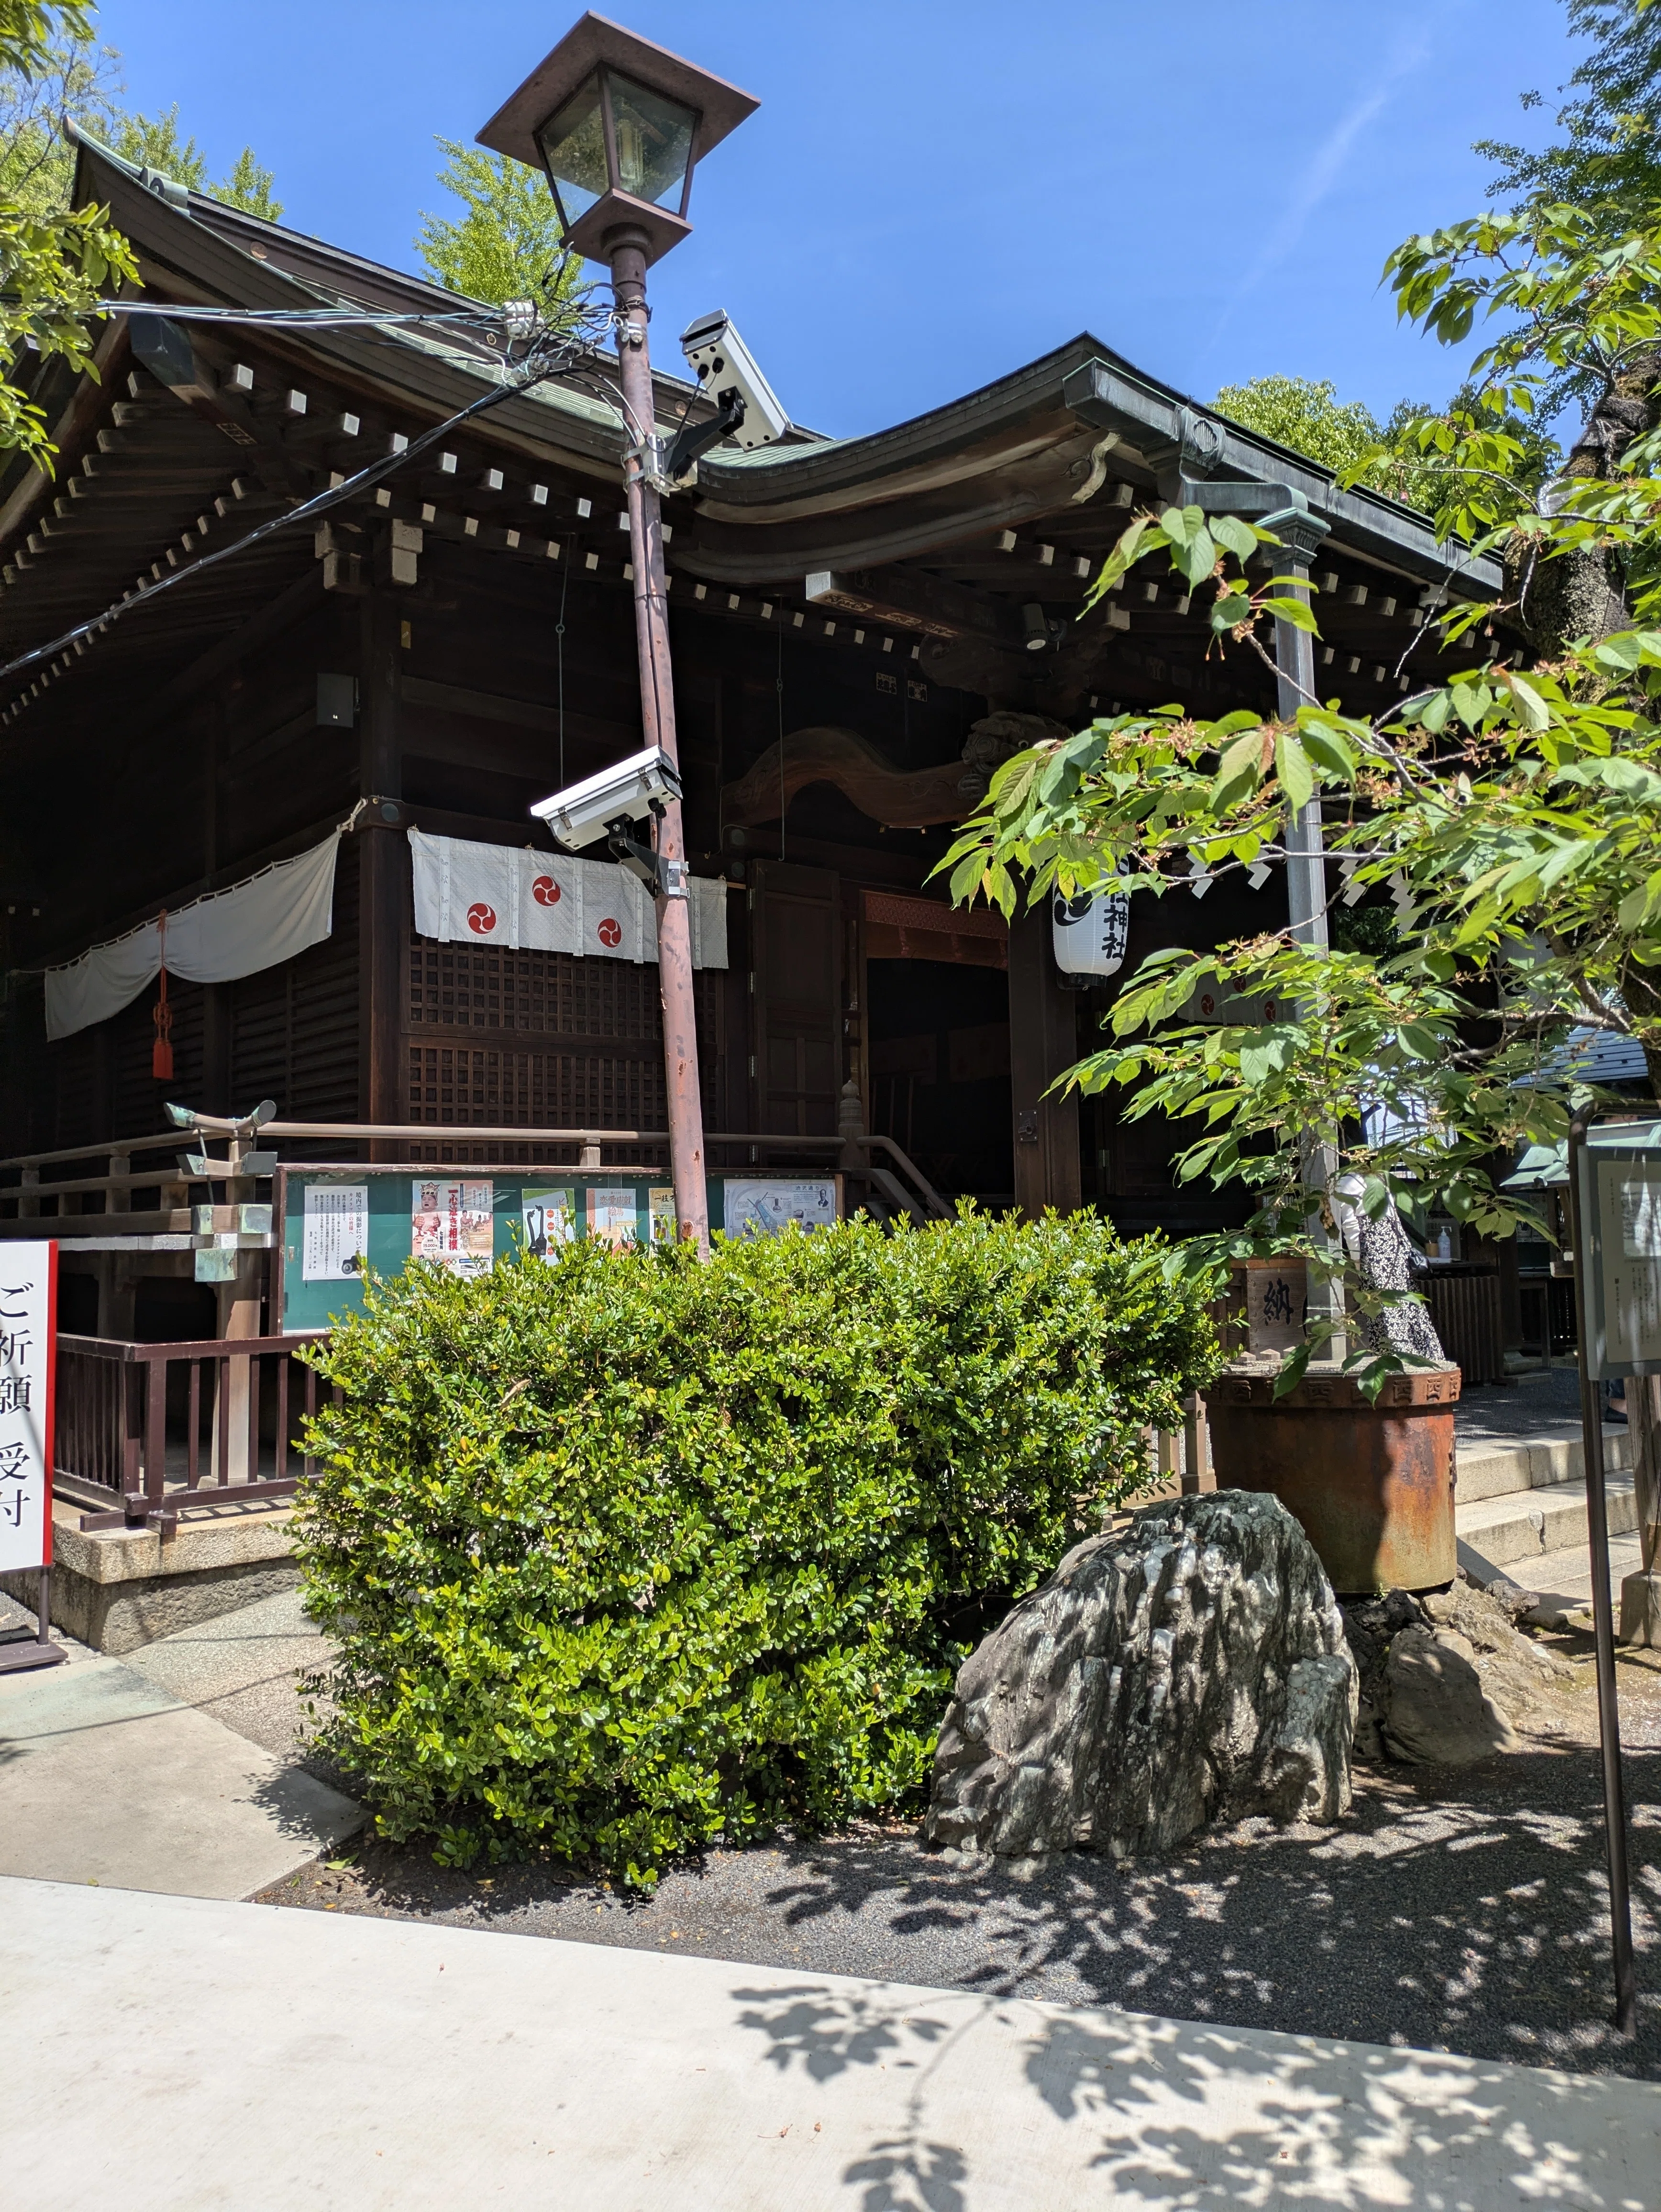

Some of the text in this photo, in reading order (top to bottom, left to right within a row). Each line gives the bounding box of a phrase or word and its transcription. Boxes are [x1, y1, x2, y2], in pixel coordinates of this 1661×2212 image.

[599, 1195, 632, 1206] 恋愛成就
[608, 1206, 624, 1217] 絵馬
[448, 1189, 458, 1251] 一心泣き相撲
